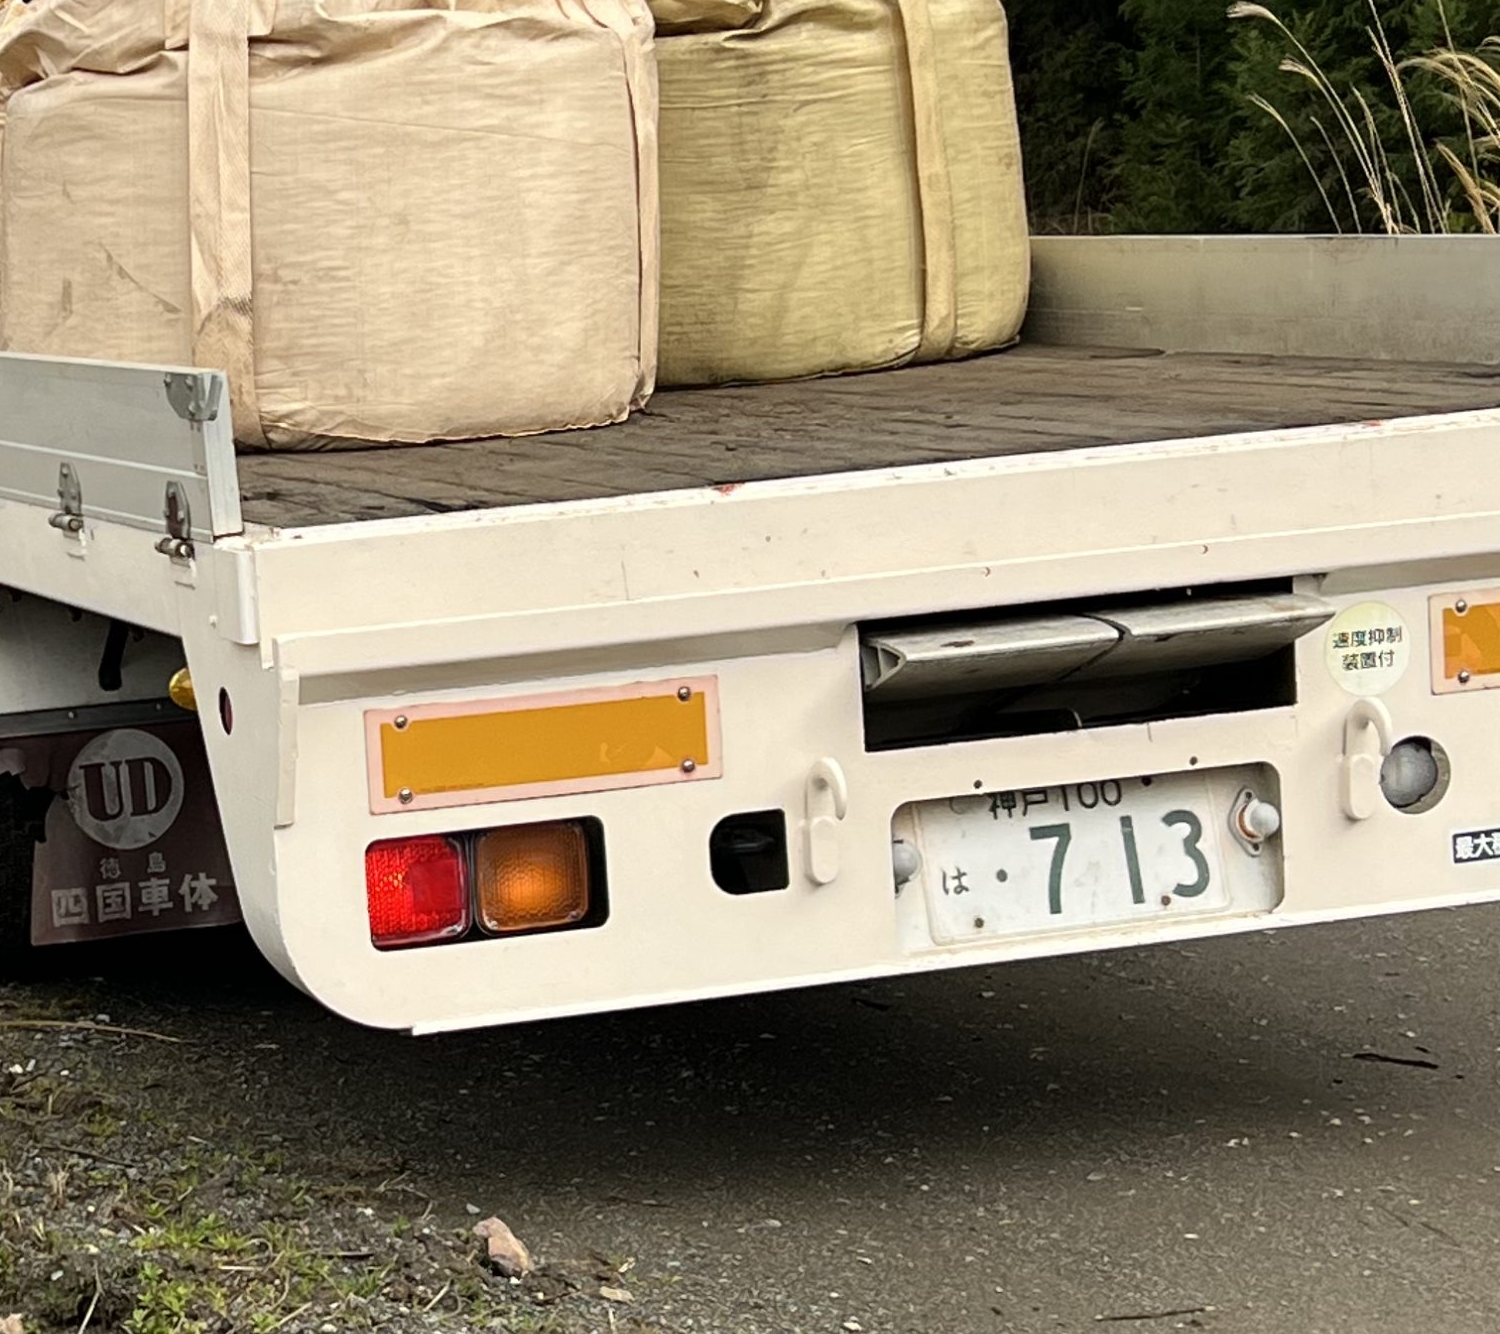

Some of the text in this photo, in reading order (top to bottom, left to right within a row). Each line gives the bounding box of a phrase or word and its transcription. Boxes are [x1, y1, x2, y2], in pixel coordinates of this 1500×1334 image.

[1332, 626, 1403, 649] 速度抑制
[1342, 649, 1394, 671] 装置付
[79, 757, 172, 821] UD
[942, 867, 970, 896] は
[51, 872, 219, 928] 四国車体
